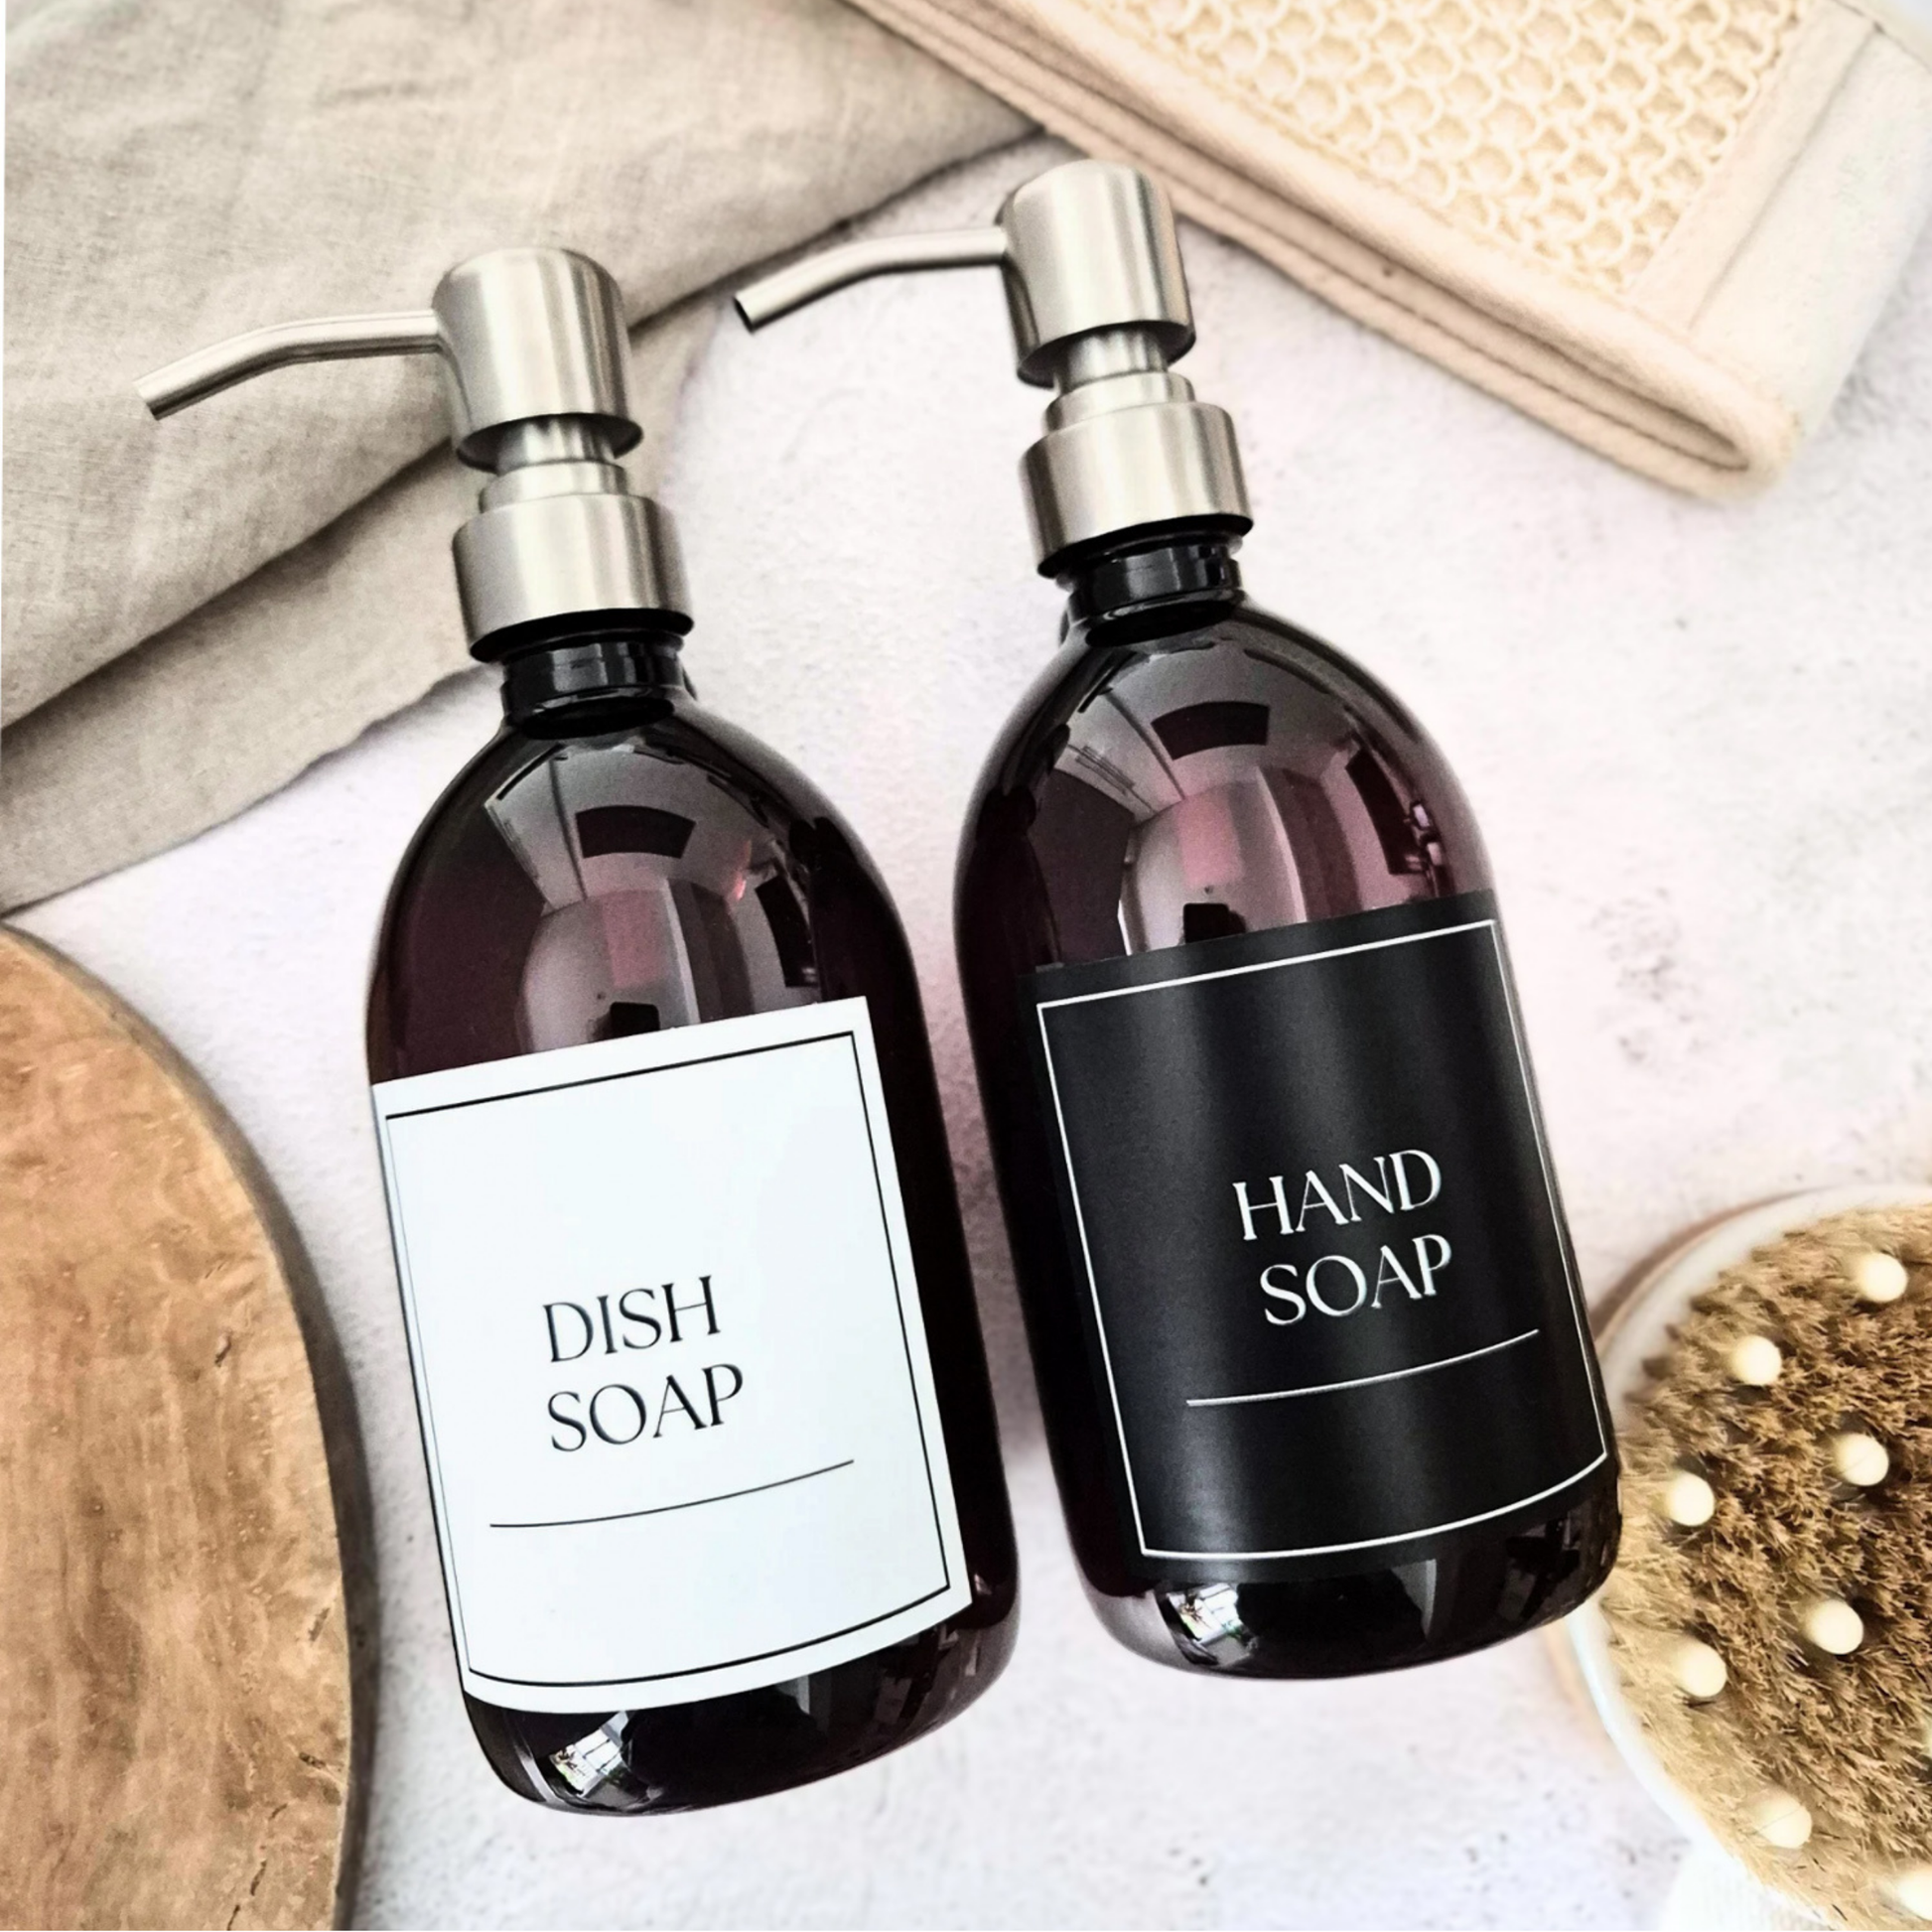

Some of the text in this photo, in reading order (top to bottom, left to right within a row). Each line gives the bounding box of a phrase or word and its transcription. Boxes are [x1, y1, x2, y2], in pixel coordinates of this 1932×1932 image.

[1232, 1149, 1443, 1241] HAND
[542, 1275, 721, 1363] DISH
[1259, 1234, 1452, 1326] SOAP
[547, 1363, 745, 1452] SOAP
